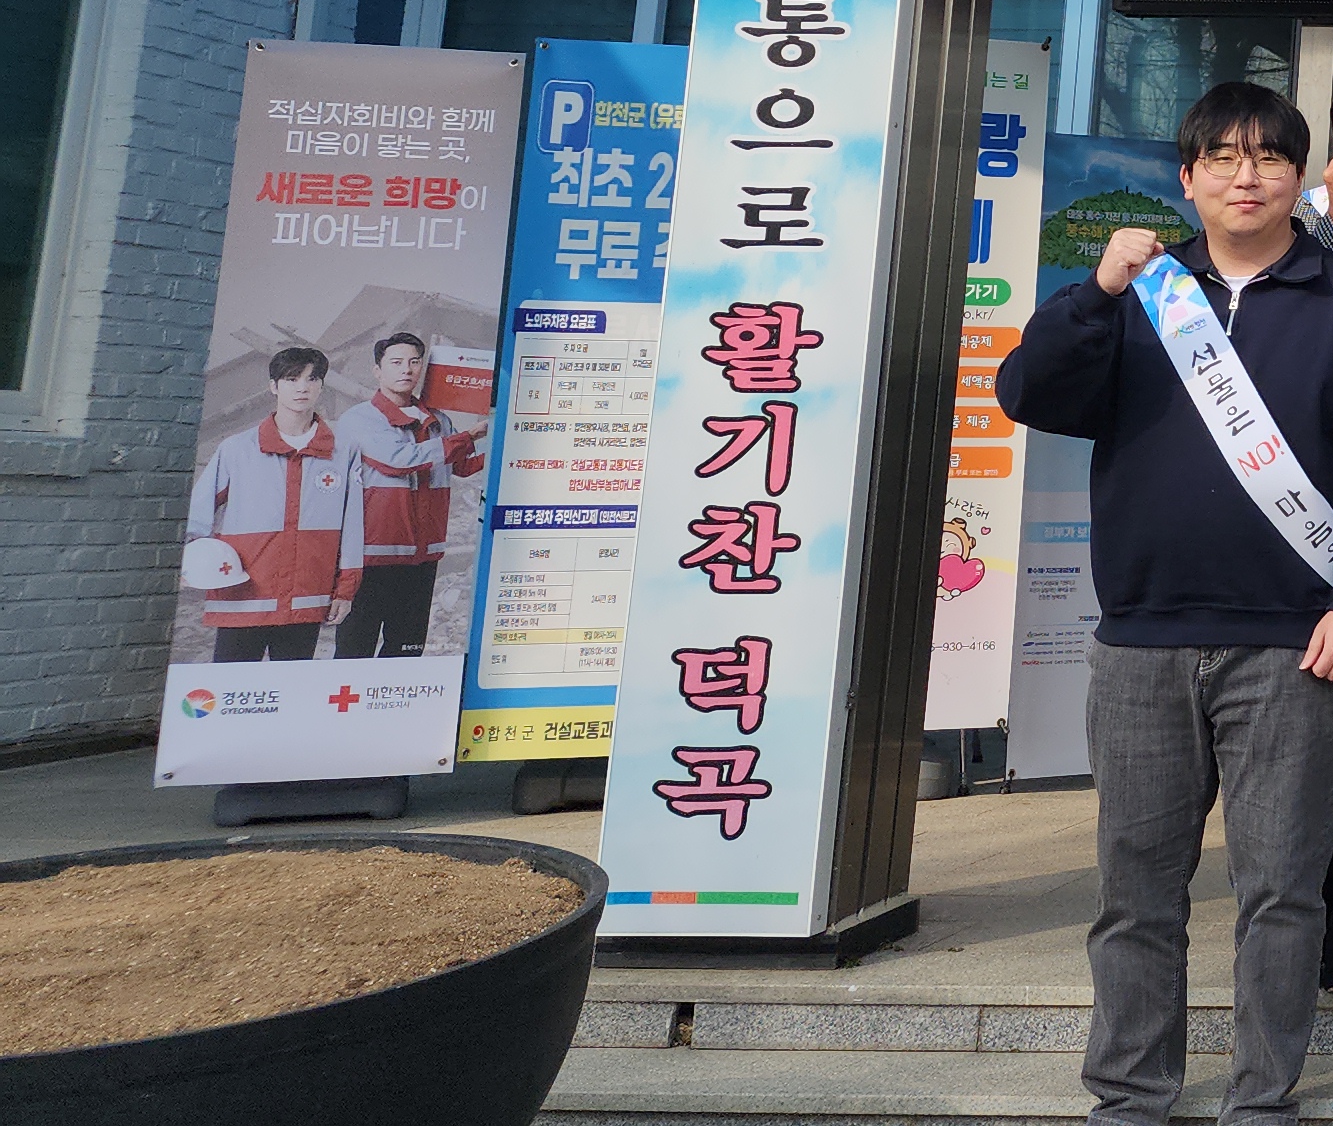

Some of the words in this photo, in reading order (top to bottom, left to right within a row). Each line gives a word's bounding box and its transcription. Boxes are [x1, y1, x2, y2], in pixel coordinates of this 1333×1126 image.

[984, 72, 1008, 89] 는
[1013, 73, 1029, 90] 길
[267, 99, 435, 130] 적십자회비와
[441, 107, 496, 133] 함께
[550, 90, 584, 144] P
[594, 100, 647, 127] 합천군
[285, 130, 369, 156] 마음이
[377, 134, 431, 159] 닿는
[438, 136, 470, 162] 곳,
[256, 172, 373, 207] 새로운
[383, 176, 487, 210] 희망이
[548, 146, 634, 208] 최초
[272, 212, 466, 250] 피어납니다
[555, 218, 641, 280] 무료
[524, 313, 569, 329] 노외주차장
[570, 313, 597, 330] 요금표
[961, 375, 996, 390] 세액공
[966, 415, 991, 430] 제공
[1190, 342, 1257, 437] 선물은
[1237, 434, 1285, 477] NO!
[678, 301, 822, 594] 활기찬
[220, 706, 279, 715] GYEONGNAM
[222, 690, 280, 705] 경상남도
[366, 685, 445, 700] 대한적십자사
[544, 721, 613, 741] 건설교통과
[652, 635, 772, 840] 덕곡
